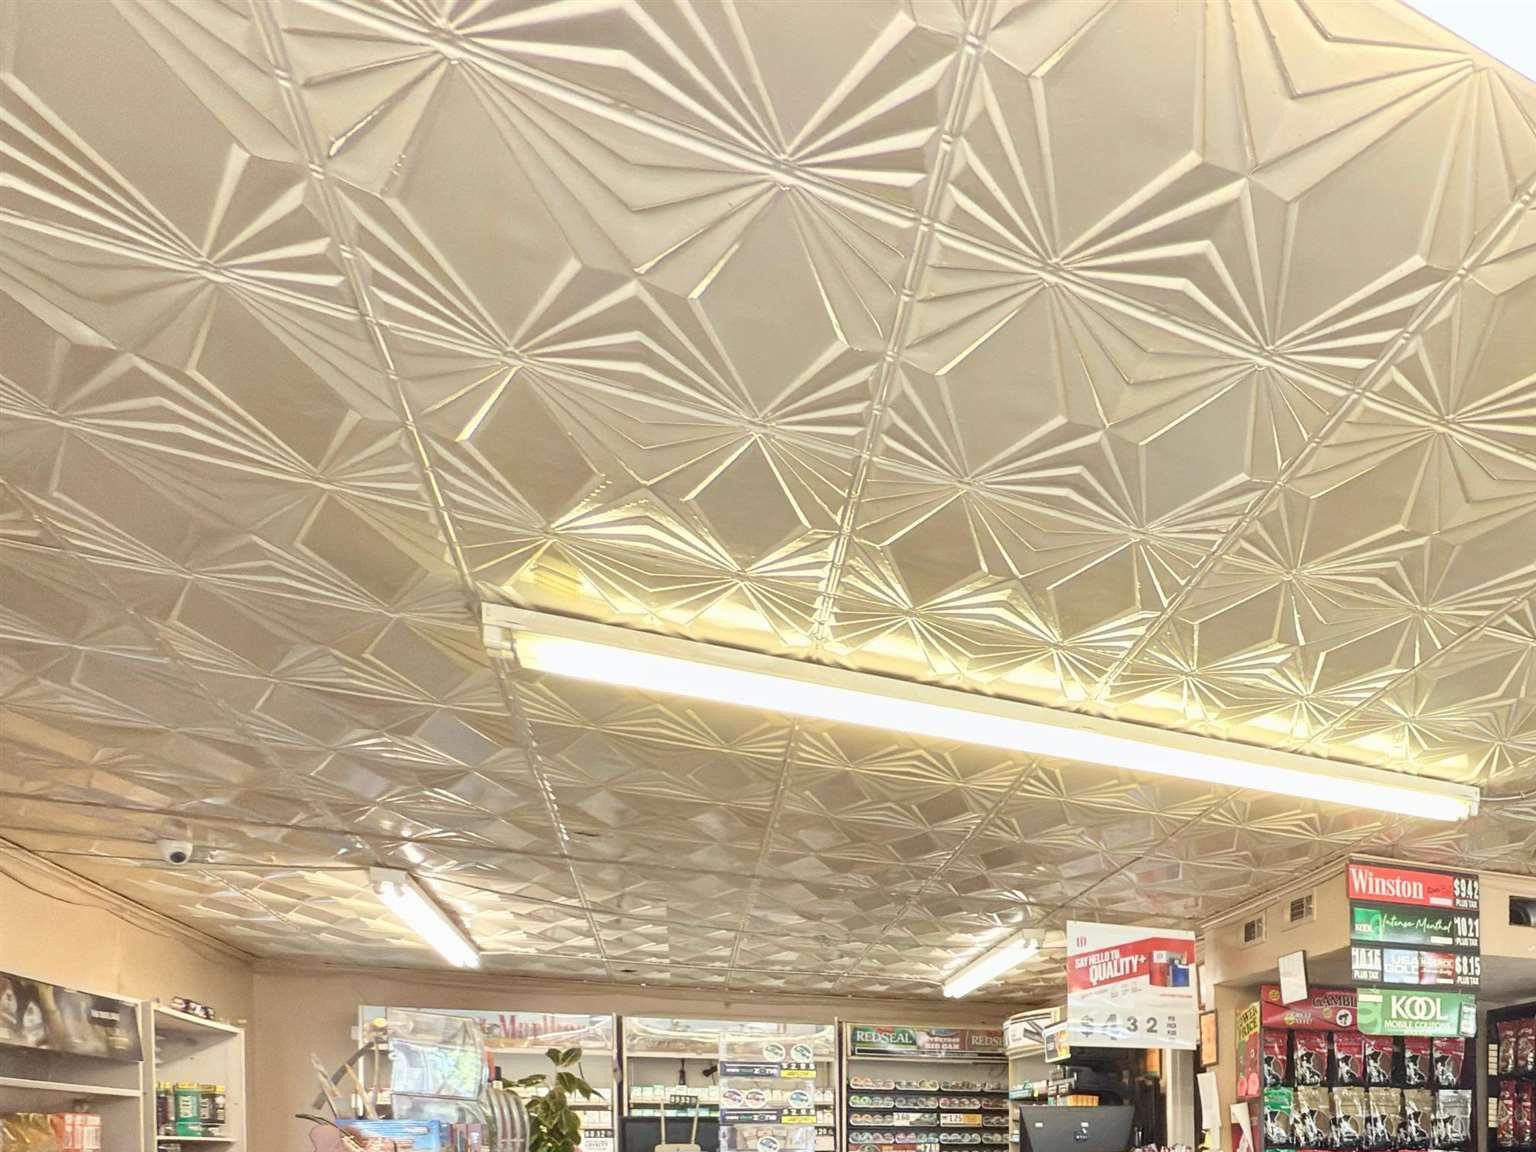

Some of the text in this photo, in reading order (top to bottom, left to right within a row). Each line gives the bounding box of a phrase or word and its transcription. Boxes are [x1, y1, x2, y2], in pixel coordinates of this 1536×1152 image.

[1349, 867, 1424, 899] Winston
[1382, 913, 1451, 932] Intense Menthol
[1075, 957, 1088, 969] SAY
[1088, 951, 1109, 965] HELLO
[1314, 992, 1357, 1008] GAMBL
[1391, 995, 1449, 1021] KOOL
